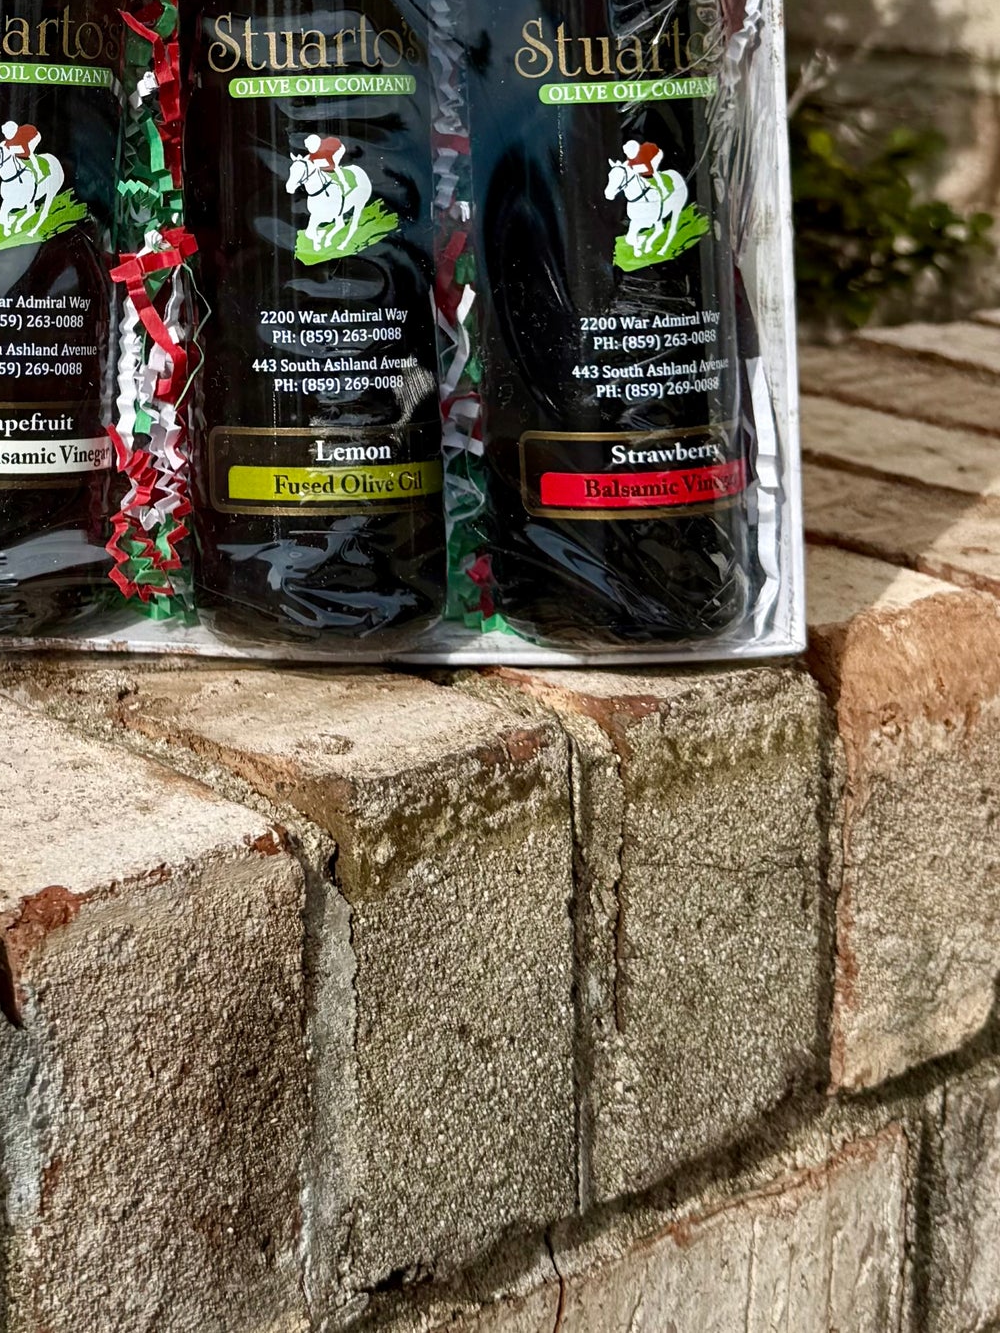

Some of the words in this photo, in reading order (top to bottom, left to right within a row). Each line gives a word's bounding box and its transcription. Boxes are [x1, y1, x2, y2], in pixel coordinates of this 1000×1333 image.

[207, 12, 423, 73] Stuarto's
[35, 66, 110, 84] COMPANY
[236, 79, 291, 95] OLIVE
[295, 78, 330, 93] OIL
[334, 77, 411, 92] COMPANY
[548, 85, 608, 101] OLIVE
[613, 83, 647, 99] OIL
[15, 295, 66, 309] Admiral
[69, 296, 91, 311] Way
[26, 315, 84, 328] 263-0088
[260, 311, 295, 324] 2200
[298, 311, 327, 324] War
[330, 309, 382, 323] Admiral
[385, 308, 408, 323] Way
[580, 317, 617, 331] 2200
[620, 317, 650, 330] War
[652, 311, 700, 328] Admiral
[701, 310, 720, 325] Way
[272, 330, 296, 343] PH:
[300, 329, 339, 346] (859)
[342, 327, 402, 342] 263-0088
[593, 336, 619, 350] PH:
[622, 335, 661, 352] (859)
[664, 329, 716, 348] 263-0088
[5, 343, 58, 356] Ashland
[61, 343, 97, 356] Avenue
[25, 362, 82, 376] 269-0088
[252, 359, 277, 372] 443
[280, 358, 320, 372] South
[323, 357, 377, 372] Ashland
[380, 356, 418, 370] Avenue
[572, 365, 599, 379] 443
[602, 364, 643, 379] South
[646, 361, 697, 377] Ashland
[274, 378, 298, 392] PH:
[302, 378, 340, 394] (859)
[344, 375, 404, 390] 269-0088
[596, 384, 621, 398] PH:
[625, 383, 664, 401] (859)
[667, 377, 719, 396] 269-0088
[59, 445, 110, 466] Vinegar
[316, 440, 391, 462] Lemon
[274, 474, 335, 495] Fused
[341, 473, 394, 494] Olive
[398, 471, 423, 490] Oil
[584, 479, 679, 499] Balsamic
